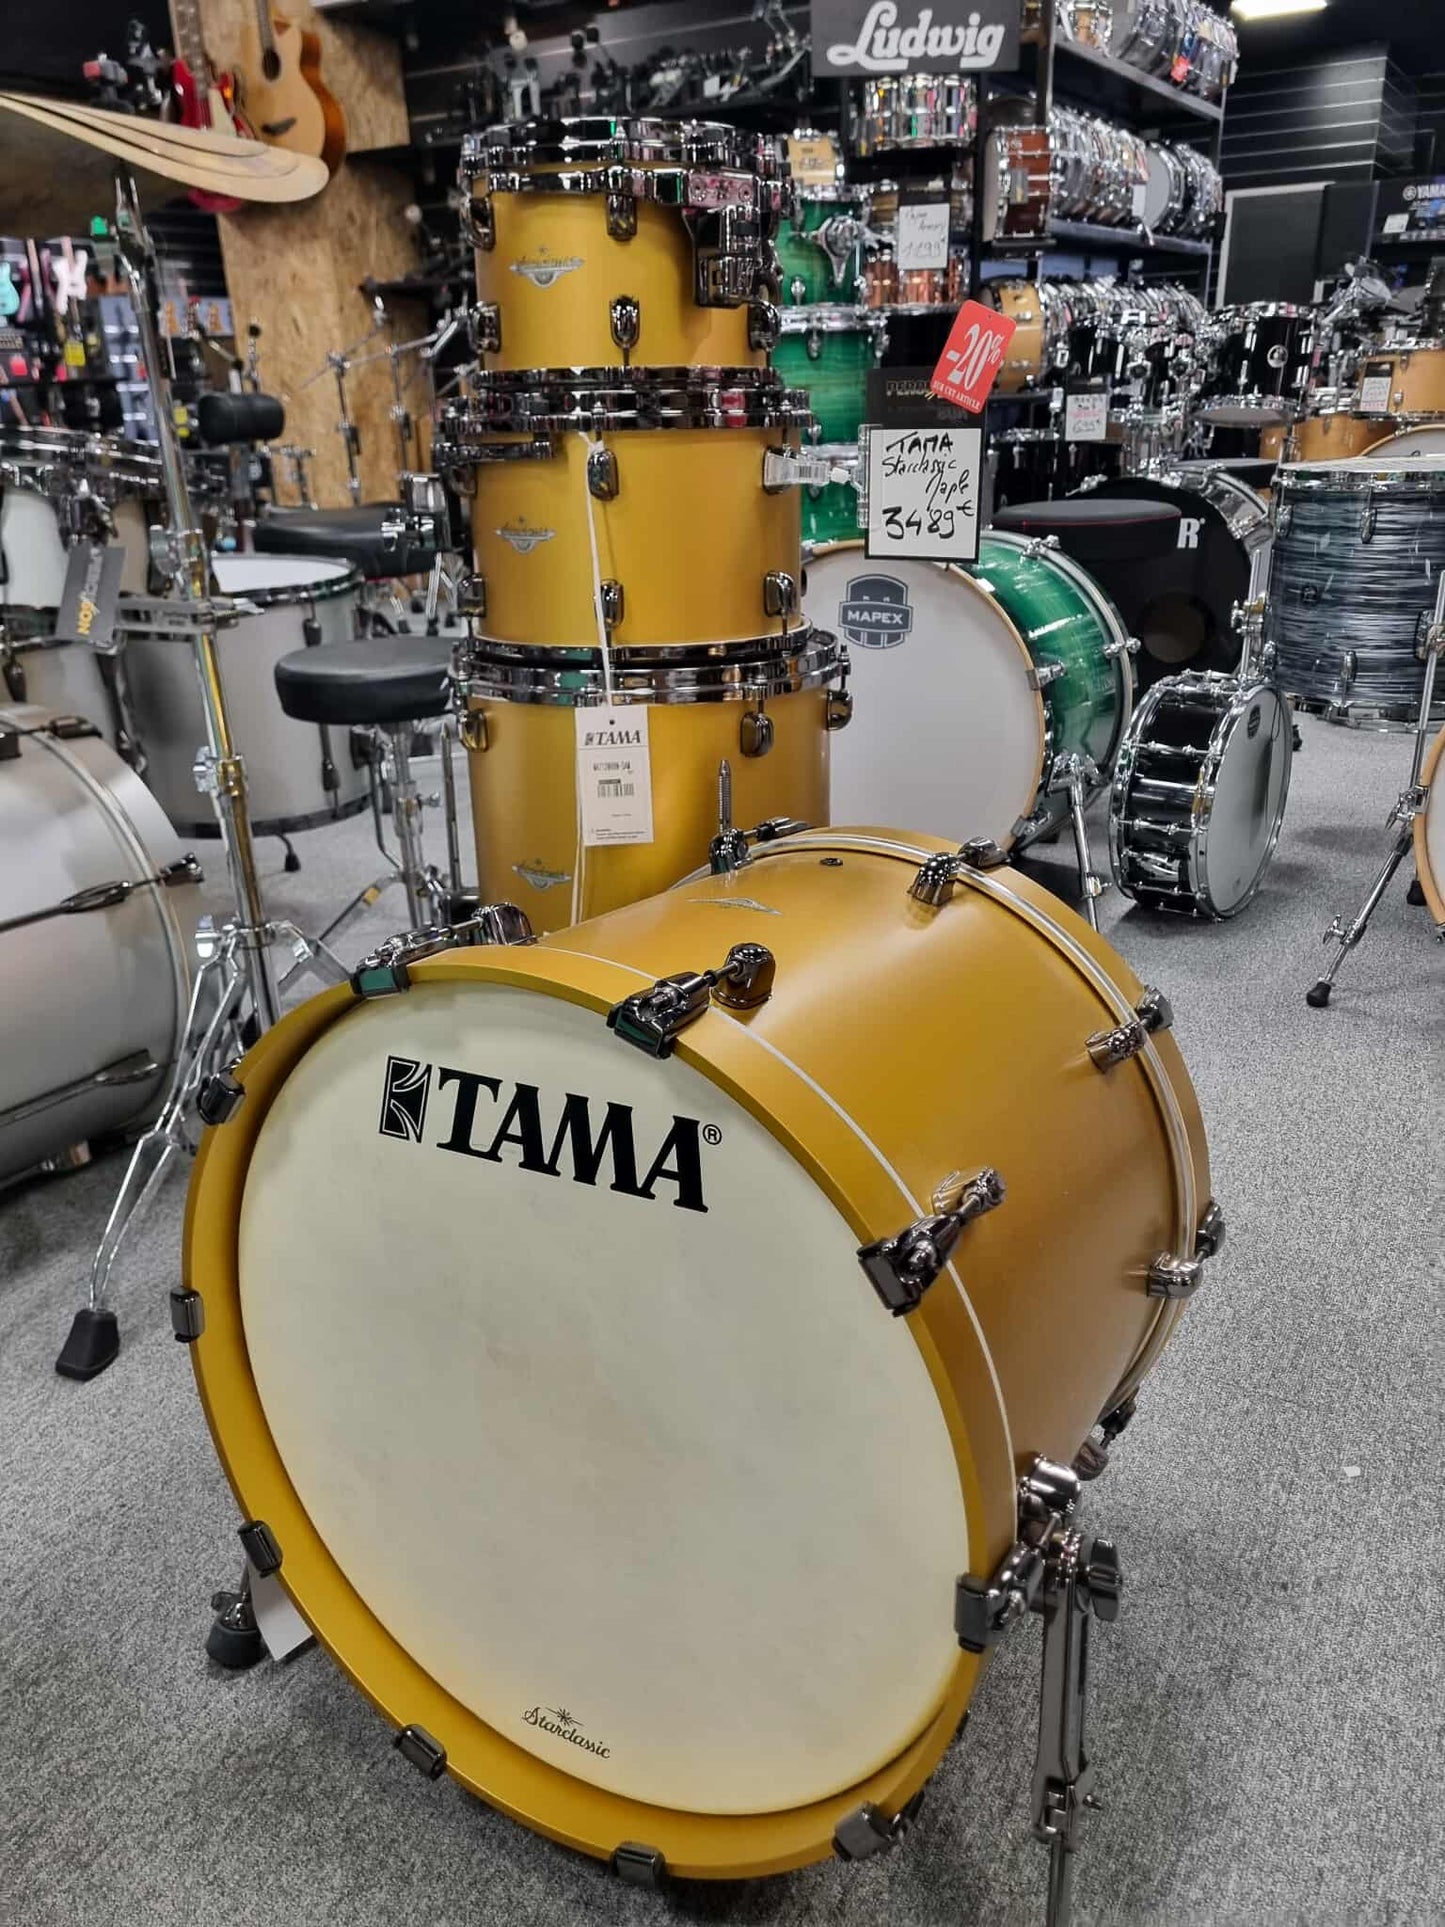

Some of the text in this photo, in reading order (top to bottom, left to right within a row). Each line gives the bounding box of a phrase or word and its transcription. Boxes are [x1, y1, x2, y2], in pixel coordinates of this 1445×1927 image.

[826, 0, 1006, 71] Ludwig
[946, 323, 1006, 391] -20%
[955, 391, 981, 410] ARTICLE
[886, 431, 953, 454] TAMA
[1177, 517, 1200, 549] R
[847, 610, 904, 625] MAPEX
[595, 730, 642, 746] TAMA
[522, 1706, 611, 1759] Starclassic
